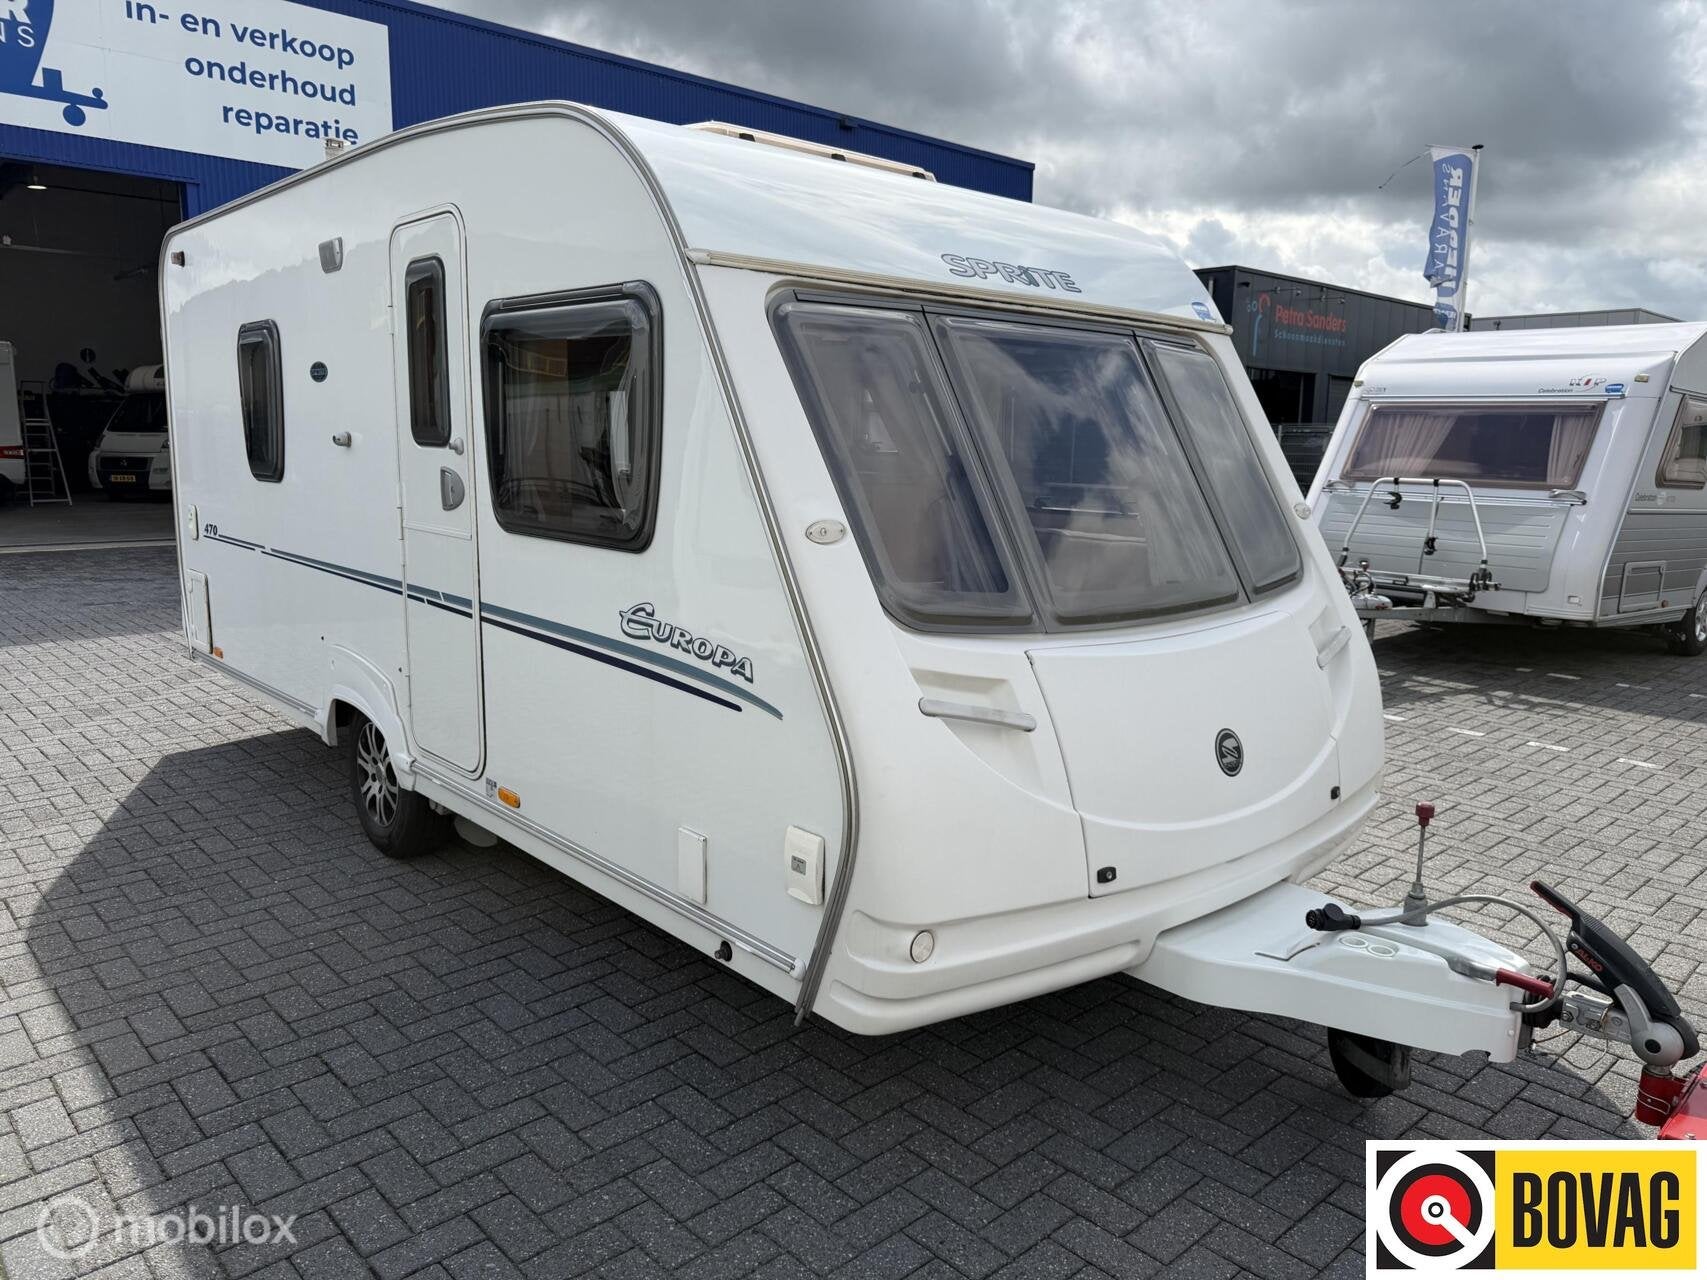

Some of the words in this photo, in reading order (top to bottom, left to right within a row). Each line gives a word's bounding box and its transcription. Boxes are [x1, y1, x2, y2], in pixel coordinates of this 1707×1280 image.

[125, 0, 170, 24] in-
[180, 12, 221, 38] en
[230, 23, 355, 70] verkoop
[185, 57, 356, 106] onderhoud
[222, 105, 359, 146] reparatie
[1275, 303, 1305, 327] Petra
[1306, 310, 1346, 332] Sanders
[204, 523, 218, 536] 470
